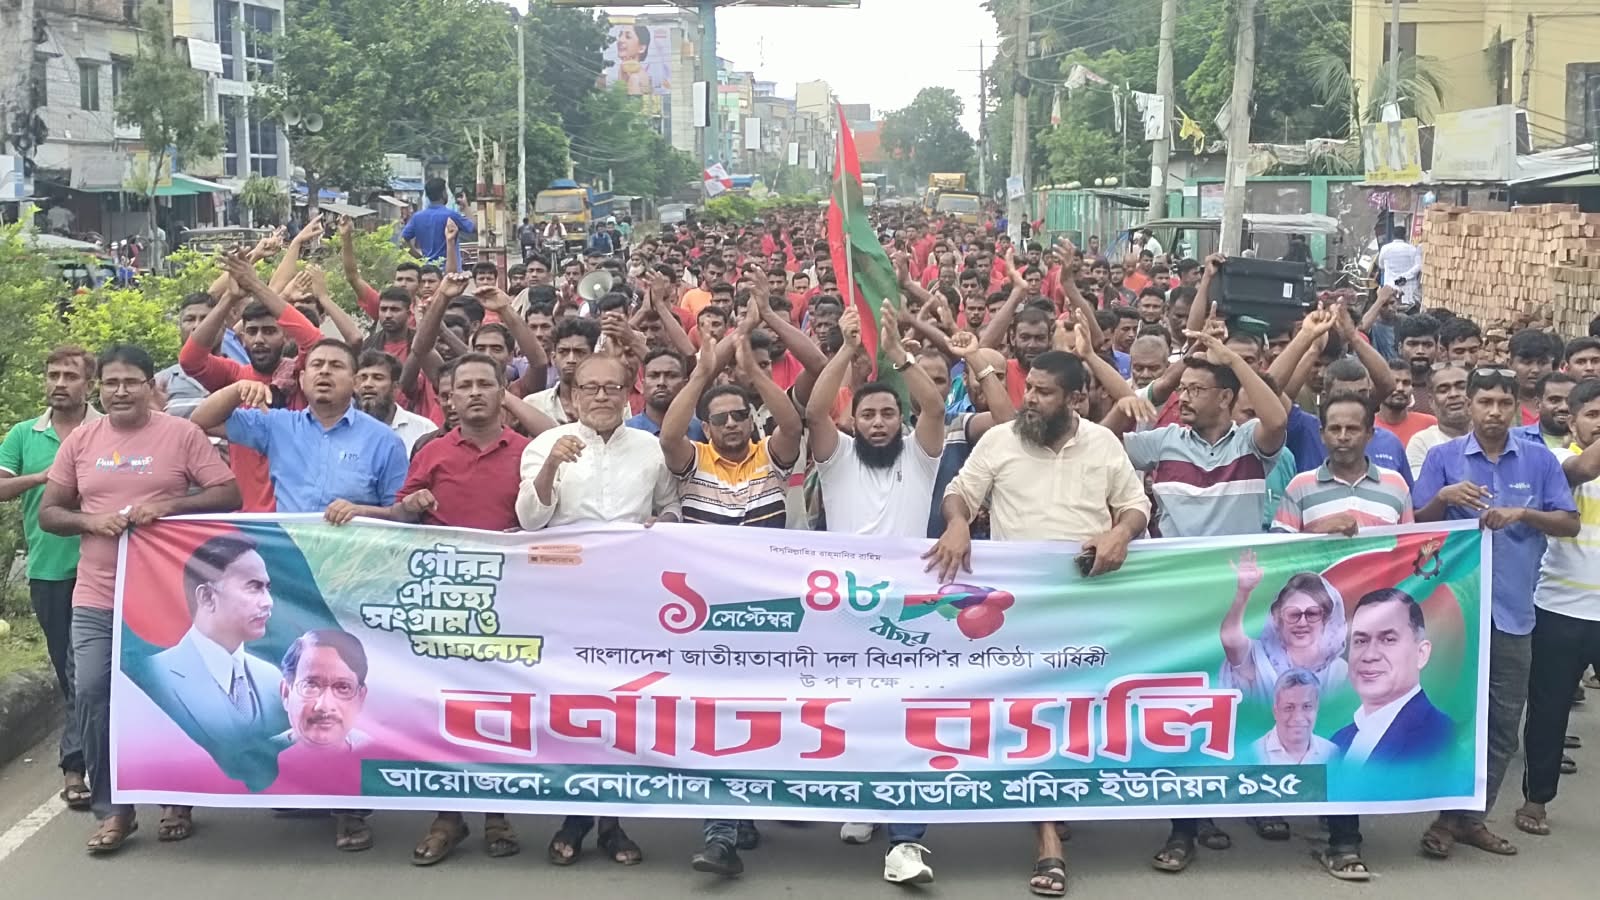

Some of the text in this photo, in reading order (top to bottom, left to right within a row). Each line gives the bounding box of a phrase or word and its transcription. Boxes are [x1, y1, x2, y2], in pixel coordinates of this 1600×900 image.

[408, 542, 505, 581] গৌরব
[397, 576, 496, 611] ঐতিহ্য
[658, 570, 796, 635] ১ সেপ্টেম্বর
[805, 569, 890, 613] ৪৮
[361, 603, 500, 634] সংগ্রাম ও
[409, 634, 544, 667] সাফল্যের
[575, 646, 673, 665] বাংলাদেশ
[680, 645, 818, 668] জাতীয়তাবাদী
[824, 651, 858, 668] দল
[967, 645, 1034, 669] প্রতিষ্ঠা
[1041, 645, 1108, 668] বার্ষিকী
[438, 671, 852, 760] বর্ণাঢ্য
[378, 767, 551, 796] আয়োজনে:
[564, 771, 713, 800] বেনাপোল
[724, 777, 775, 804] স্থল
[783, 779, 864, 804] বন্দর
[1001, 772, 1091, 804] শ্রমিক
[1098, 769, 1231, 802] ইউনিয়ন
[1237, 771, 1301, 799] ৯২৫
